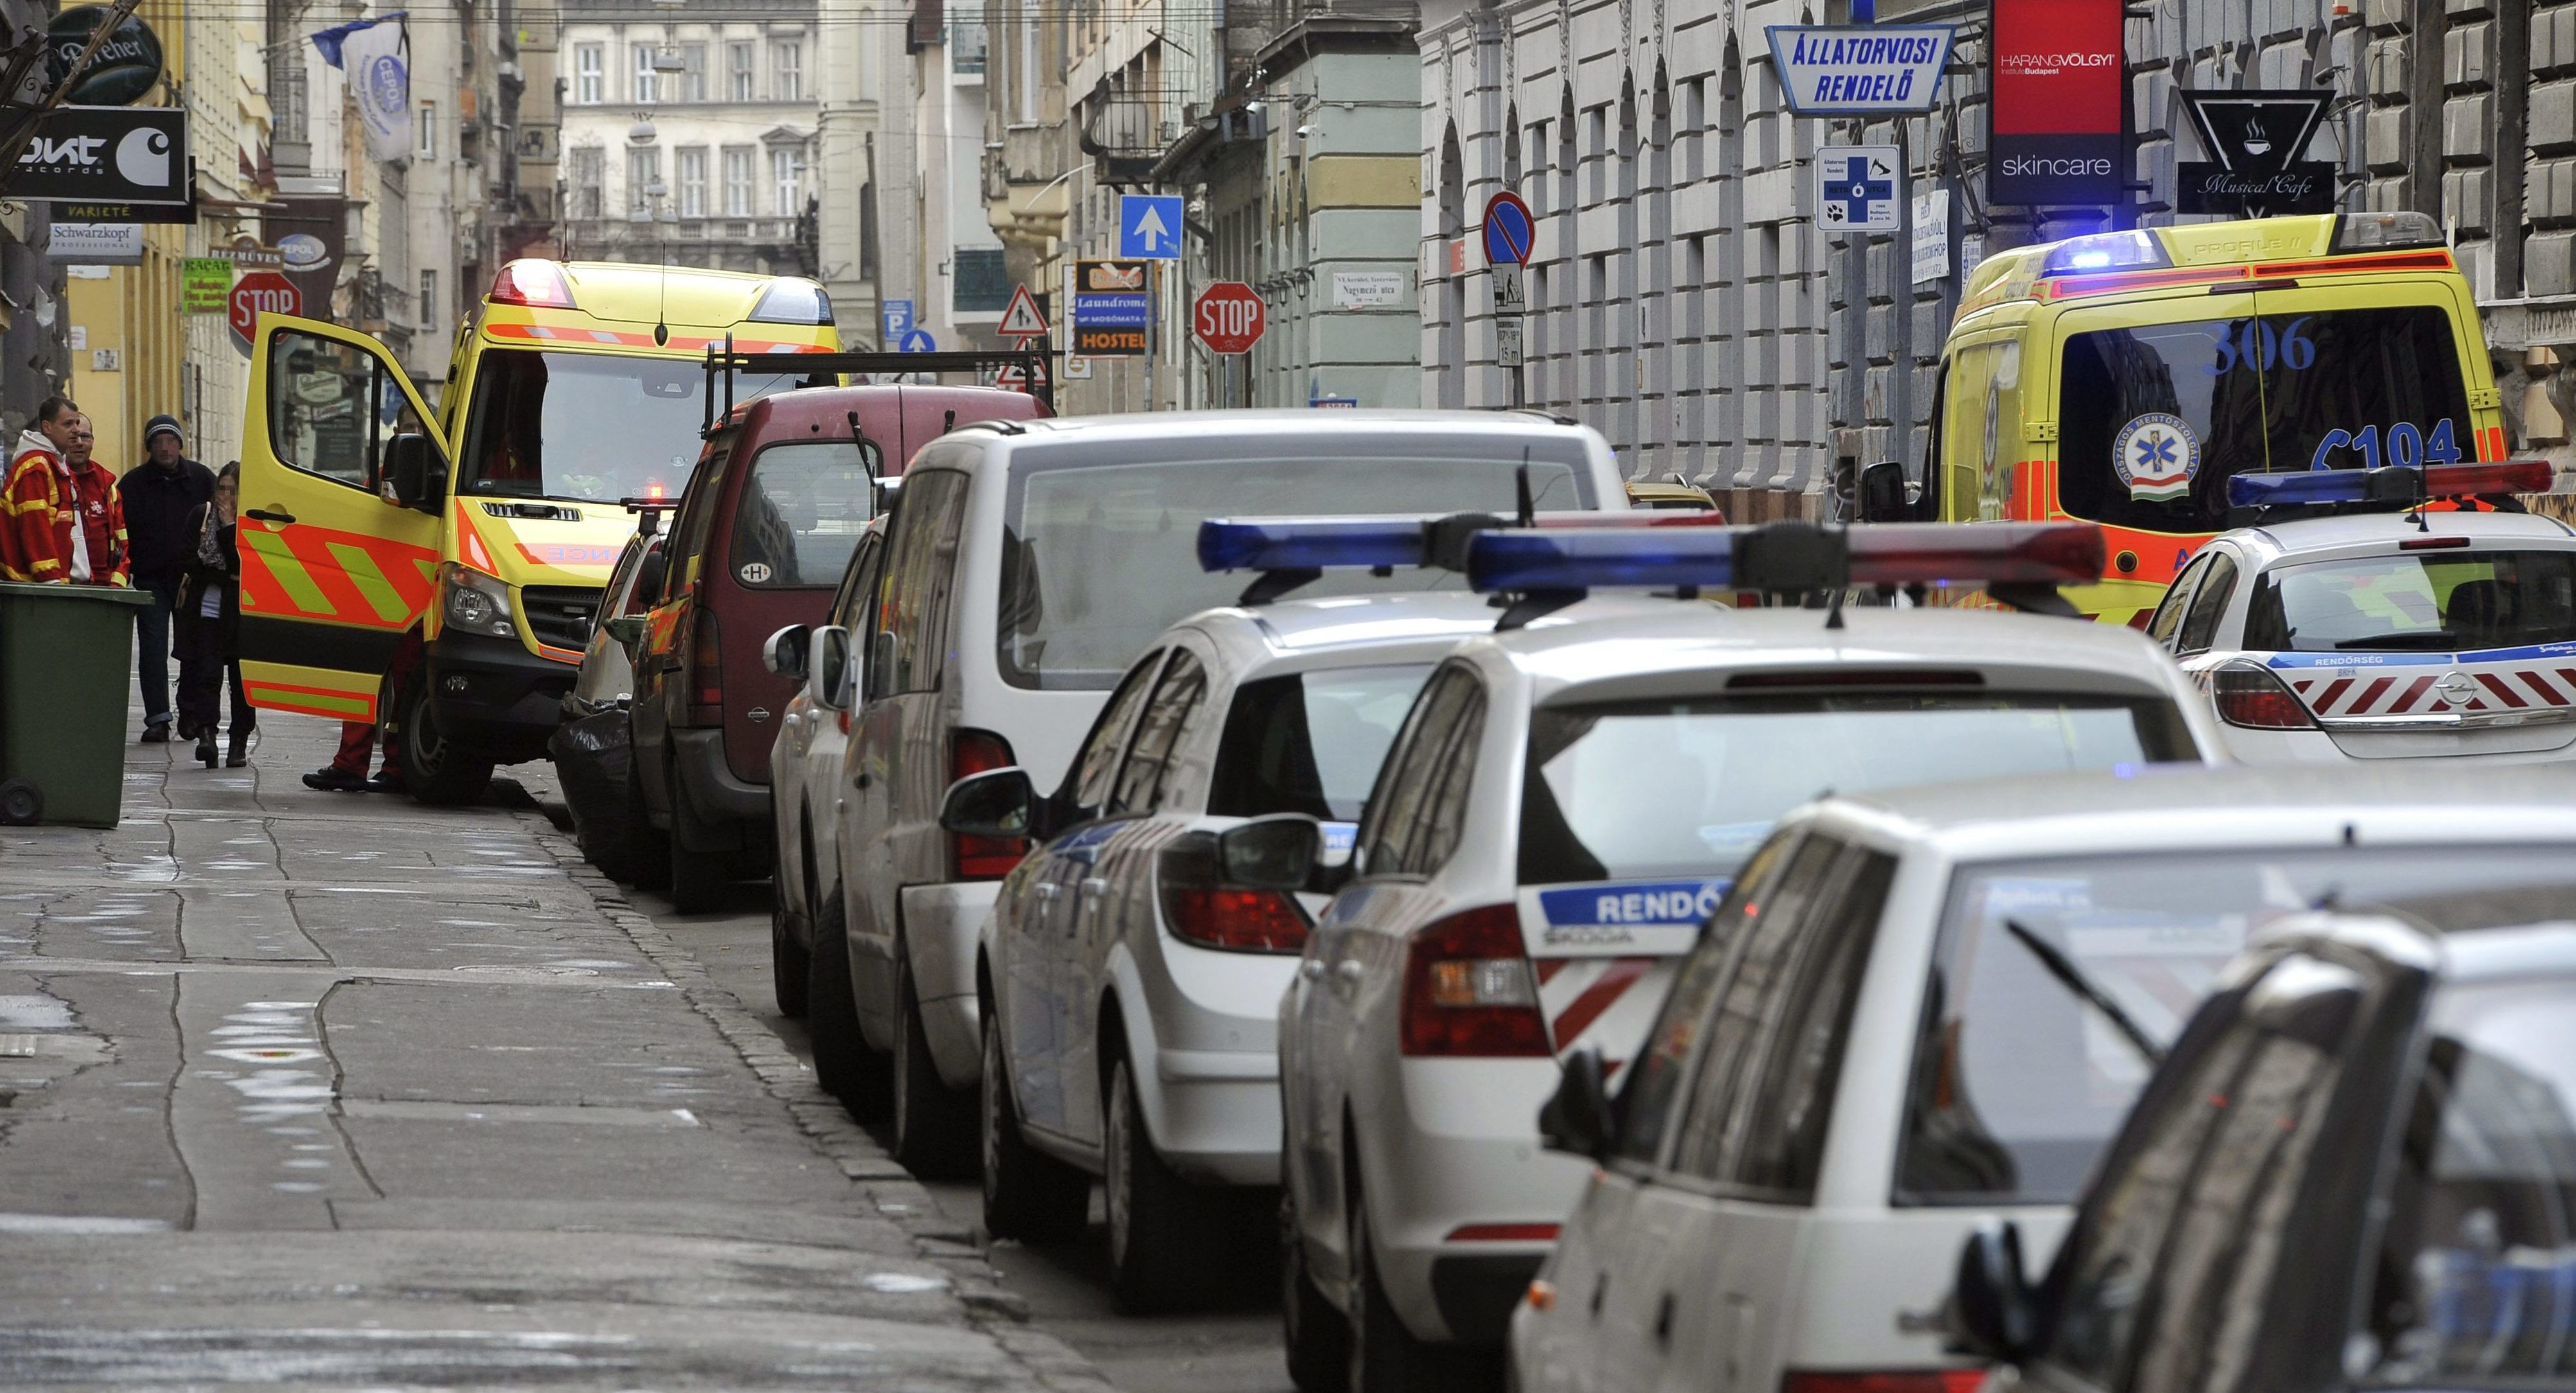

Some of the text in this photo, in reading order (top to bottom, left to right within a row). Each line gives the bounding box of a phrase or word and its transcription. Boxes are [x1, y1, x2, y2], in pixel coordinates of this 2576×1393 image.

[60, 39, 142, 70] Dreher
[1792, 33, 1938, 65] ÁLLATORVOSI
[378, 58, 400, 109] CEPOL
[2002, 154, 2111, 175] skincare
[2197, 174, 2275, 193] Musical
[54, 226, 132, 241] Schwarzkopf
[2194, 239, 2282, 256] PROFILE
[236, 290, 294, 327] STOP
[1202, 299, 1257, 336] STOP
[1082, 333, 1146, 349] HOSTEL
[2202, 317, 2315, 375] 306
[2117, 426, 2134, 480] ORSZÁGOS
[750, 565, 761, 579] H
[2315, 655, 2383, 666] RENDŐRSÉG
